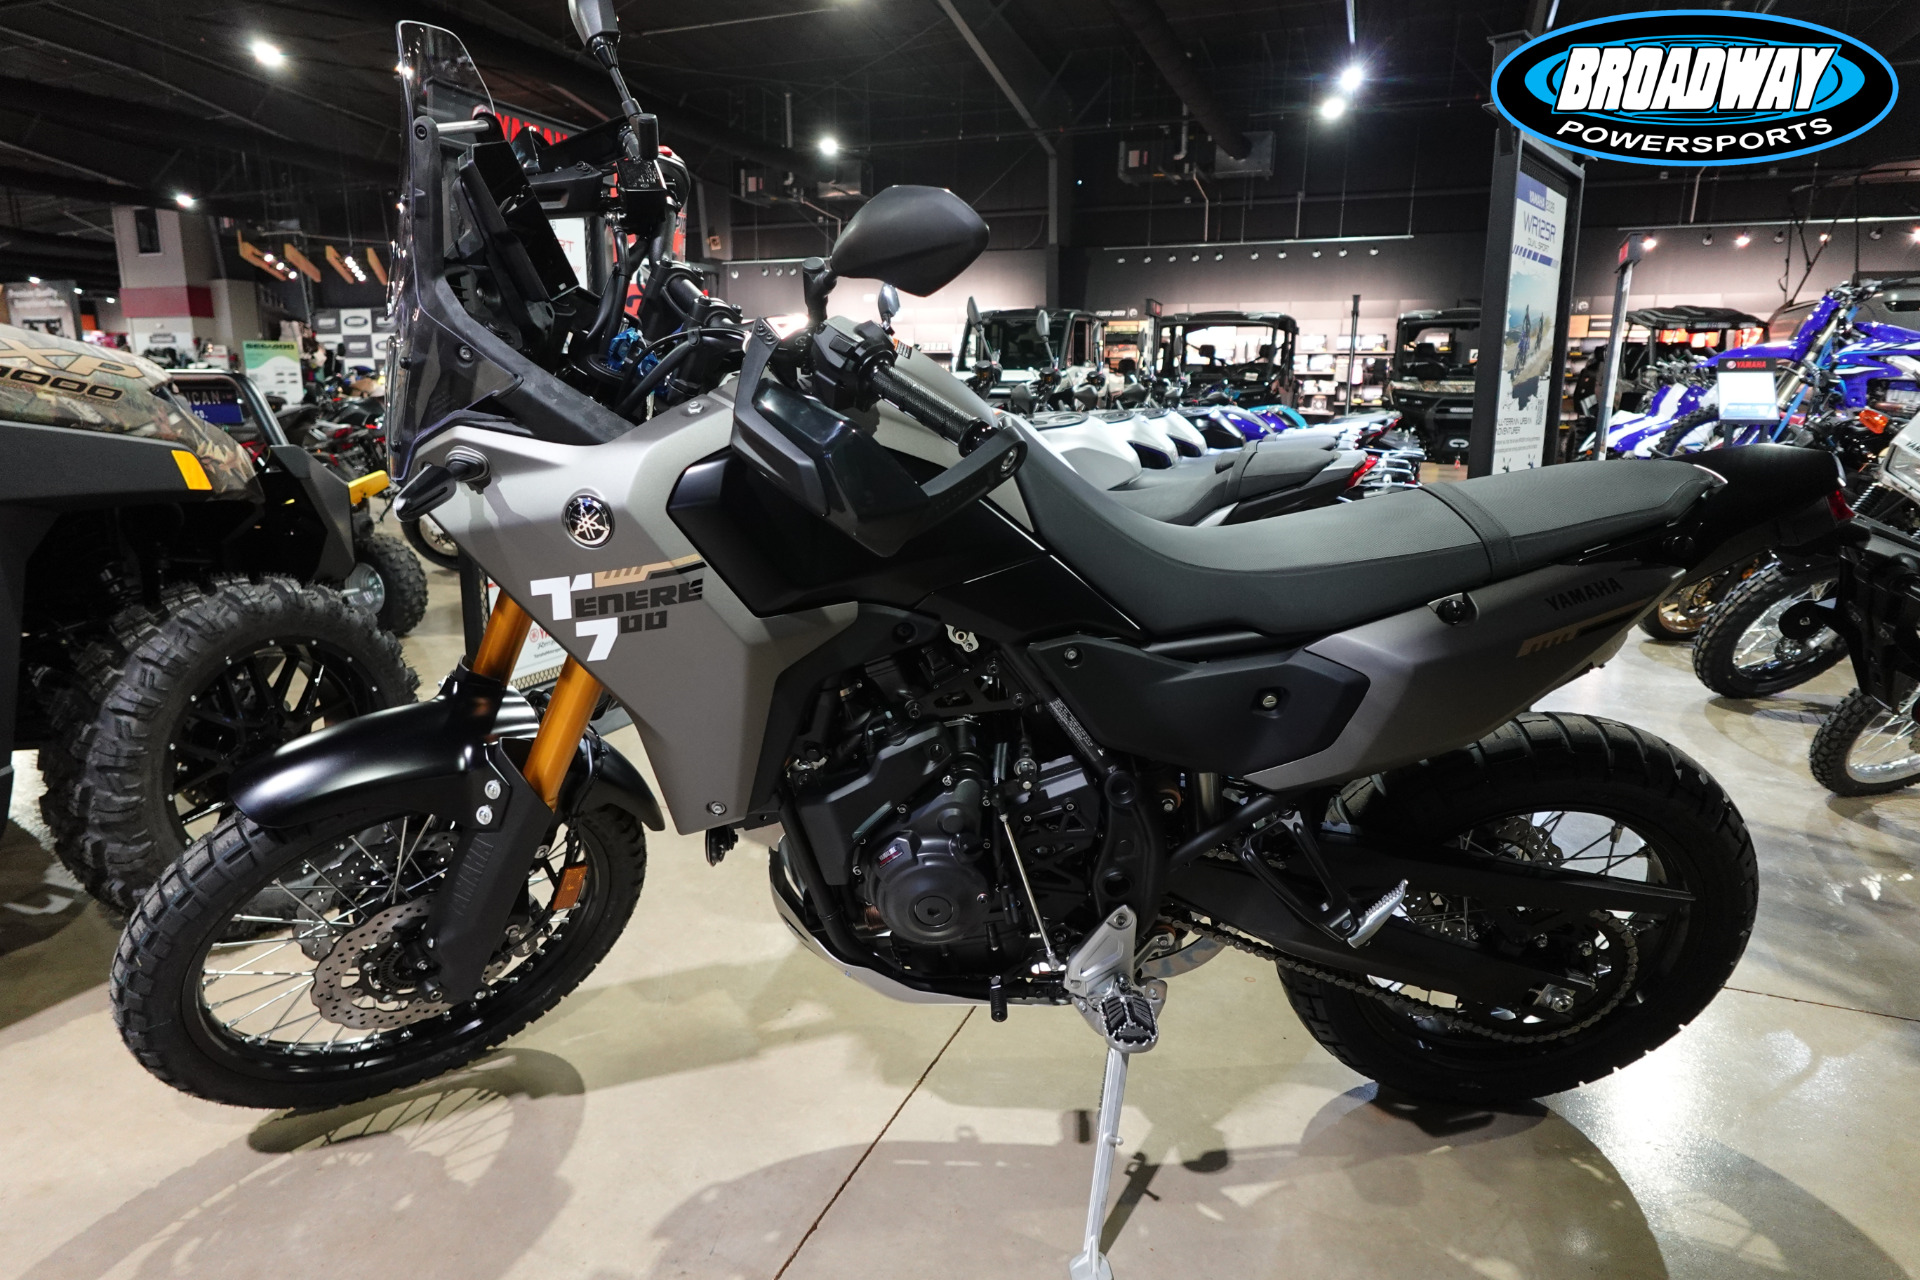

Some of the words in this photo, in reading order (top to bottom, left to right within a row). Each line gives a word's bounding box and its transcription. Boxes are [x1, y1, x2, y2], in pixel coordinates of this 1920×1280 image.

[1736, 360, 1766, 369] YAMAHA
[1544, 577, 1623, 611] YAMAHA
[575, 610, 668, 662] 700
[449, 836, 495, 917] YAMAHA
